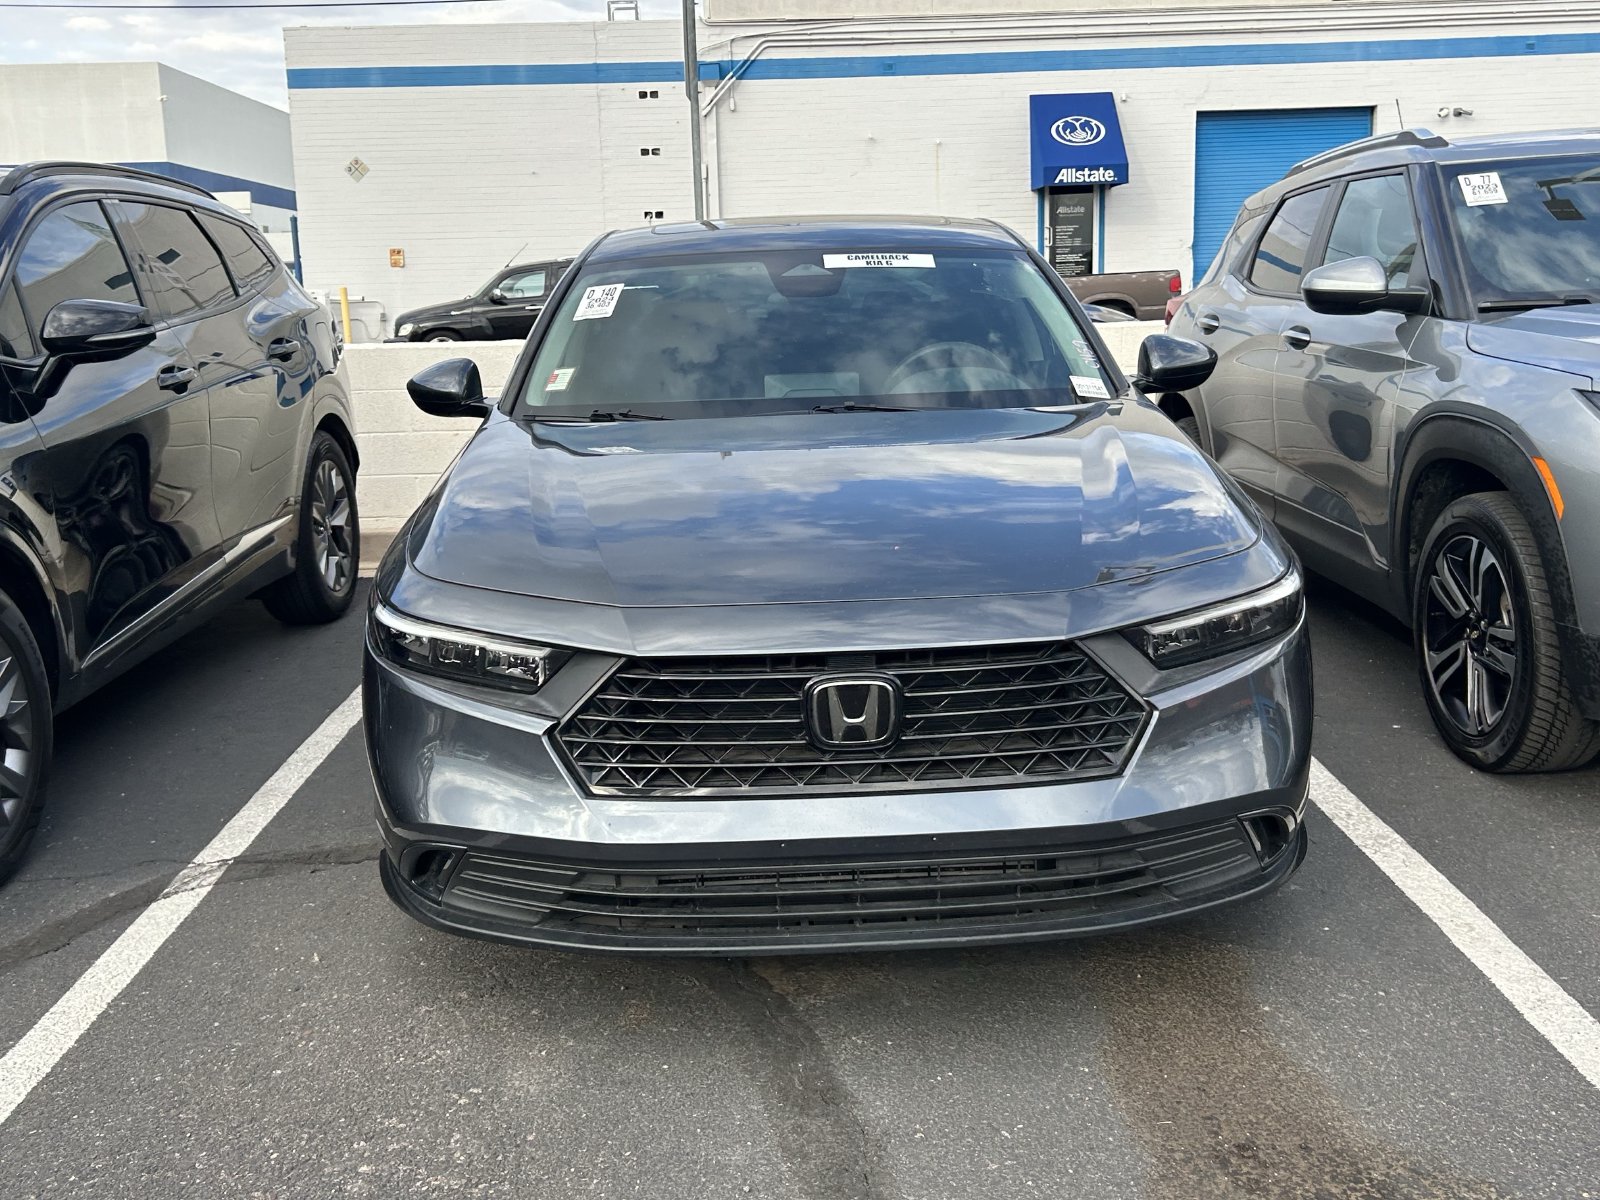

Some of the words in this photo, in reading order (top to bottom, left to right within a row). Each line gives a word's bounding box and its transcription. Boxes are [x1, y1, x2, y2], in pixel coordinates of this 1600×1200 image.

[1480, 175, 1491, 184] 77
[1471, 183, 1498, 191] 2023
[1056, 205, 1086, 214] Allstate
[600, 286, 618, 298] 140
